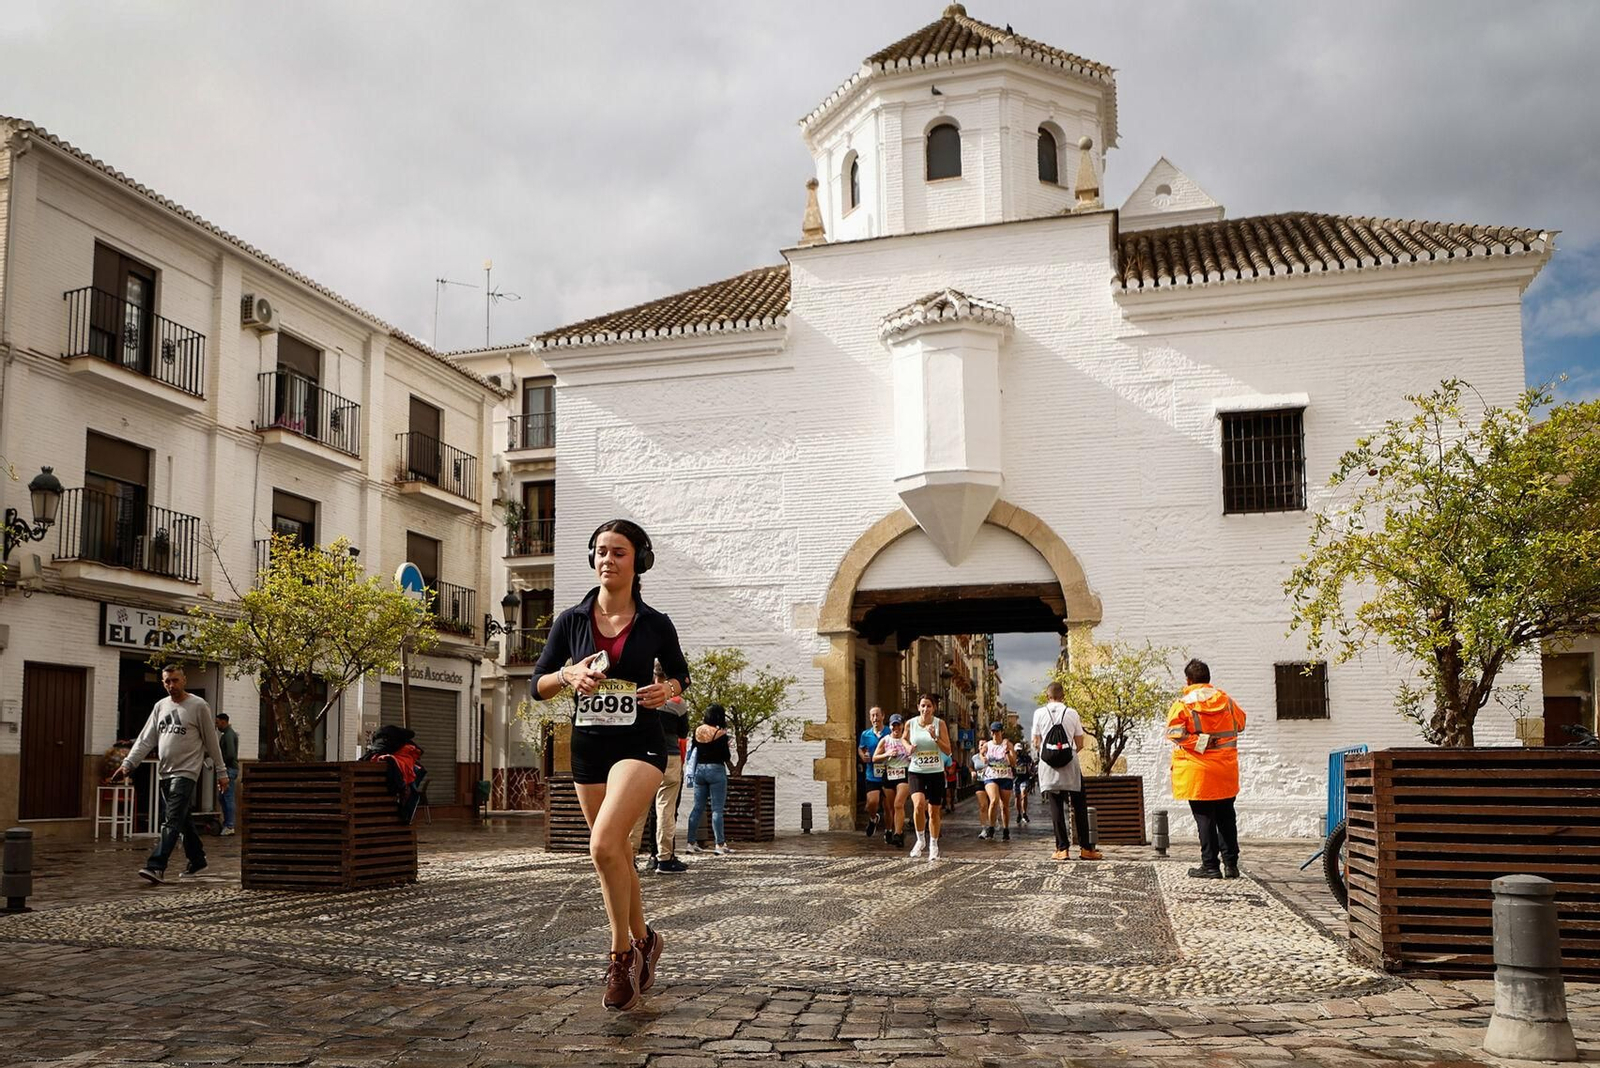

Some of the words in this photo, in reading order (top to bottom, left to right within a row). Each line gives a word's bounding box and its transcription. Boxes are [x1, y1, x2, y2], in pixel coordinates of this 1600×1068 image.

[109, 623, 137, 644] EL
[424, 665, 463, 684] Asociados
[579, 695, 634, 713] 3098
[918, 756, 940, 765] 3228
